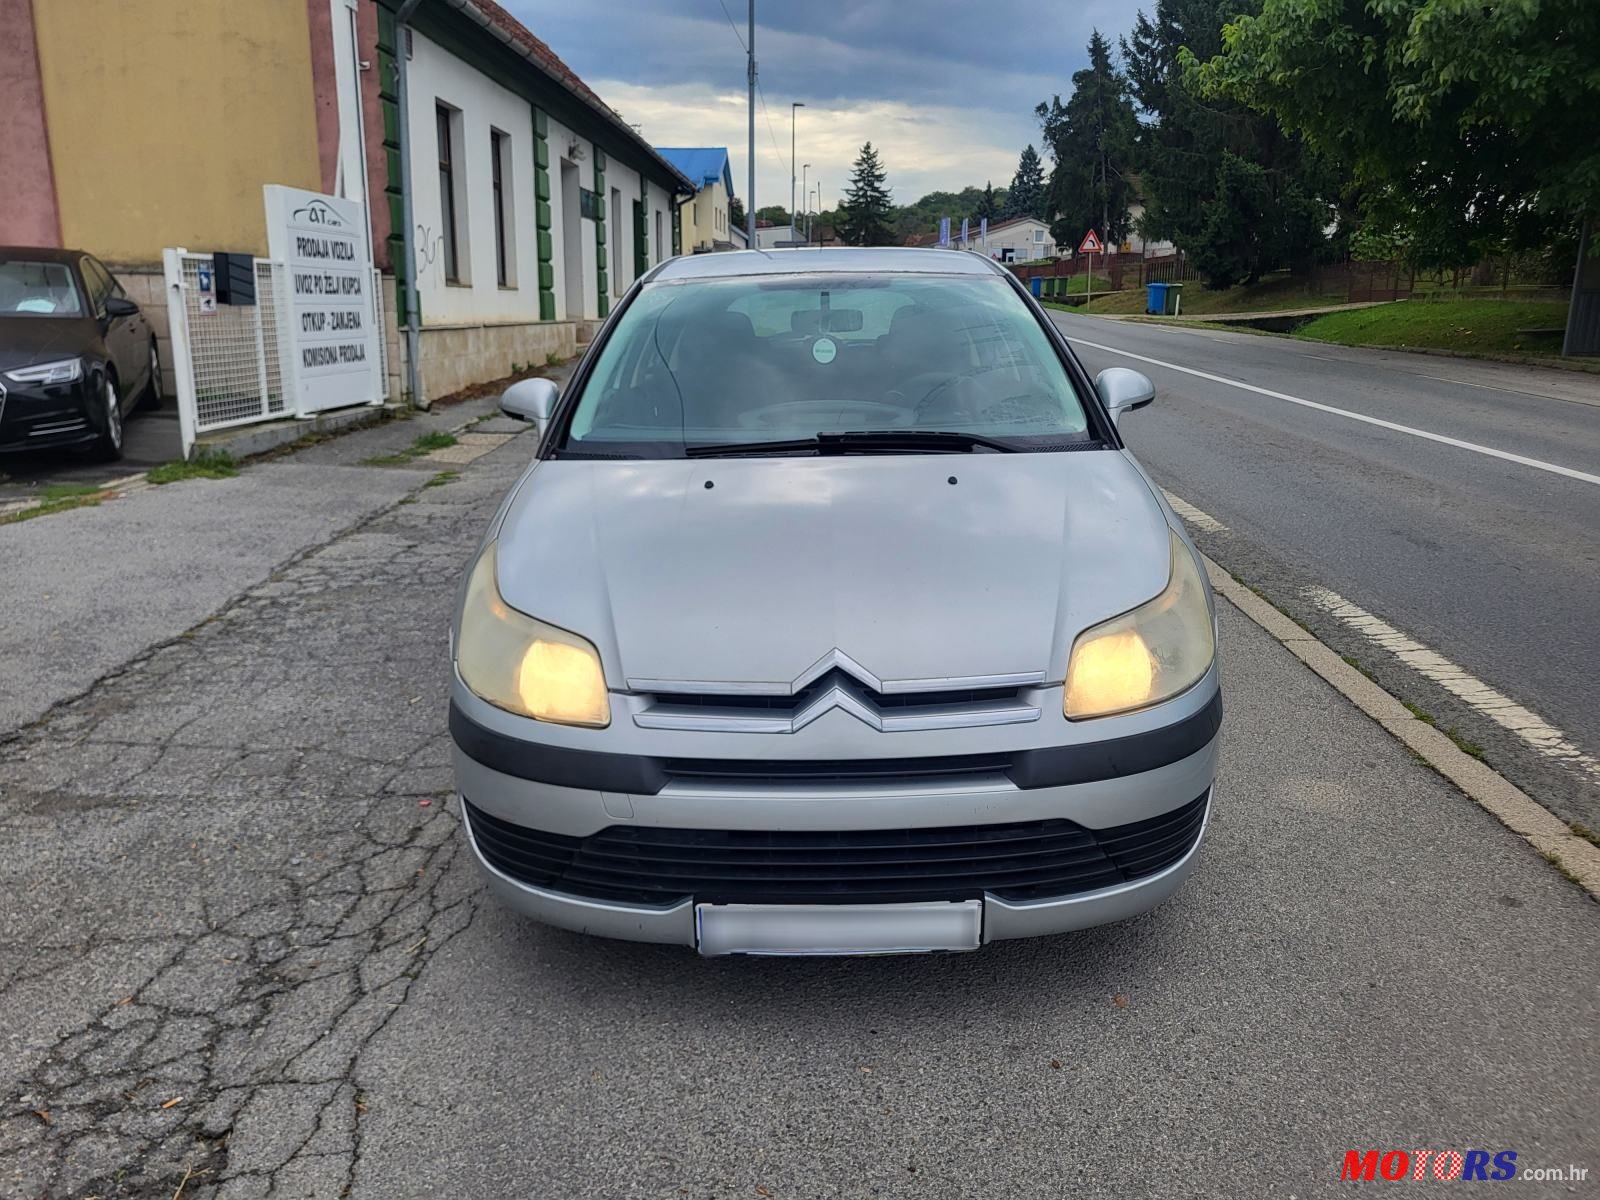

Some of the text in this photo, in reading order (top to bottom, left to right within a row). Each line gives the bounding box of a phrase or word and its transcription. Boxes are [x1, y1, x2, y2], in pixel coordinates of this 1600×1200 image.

[296, 236, 355, 261] PRODAJA VOZILA
[295, 273, 313, 294] UVOZ
[314, 274, 323, 294] PO
[342, 276, 362, 296] KUPCA
[302, 312, 326, 332] OTKUP
[302, 344, 366, 368] KOMISIONA PRODAJA
